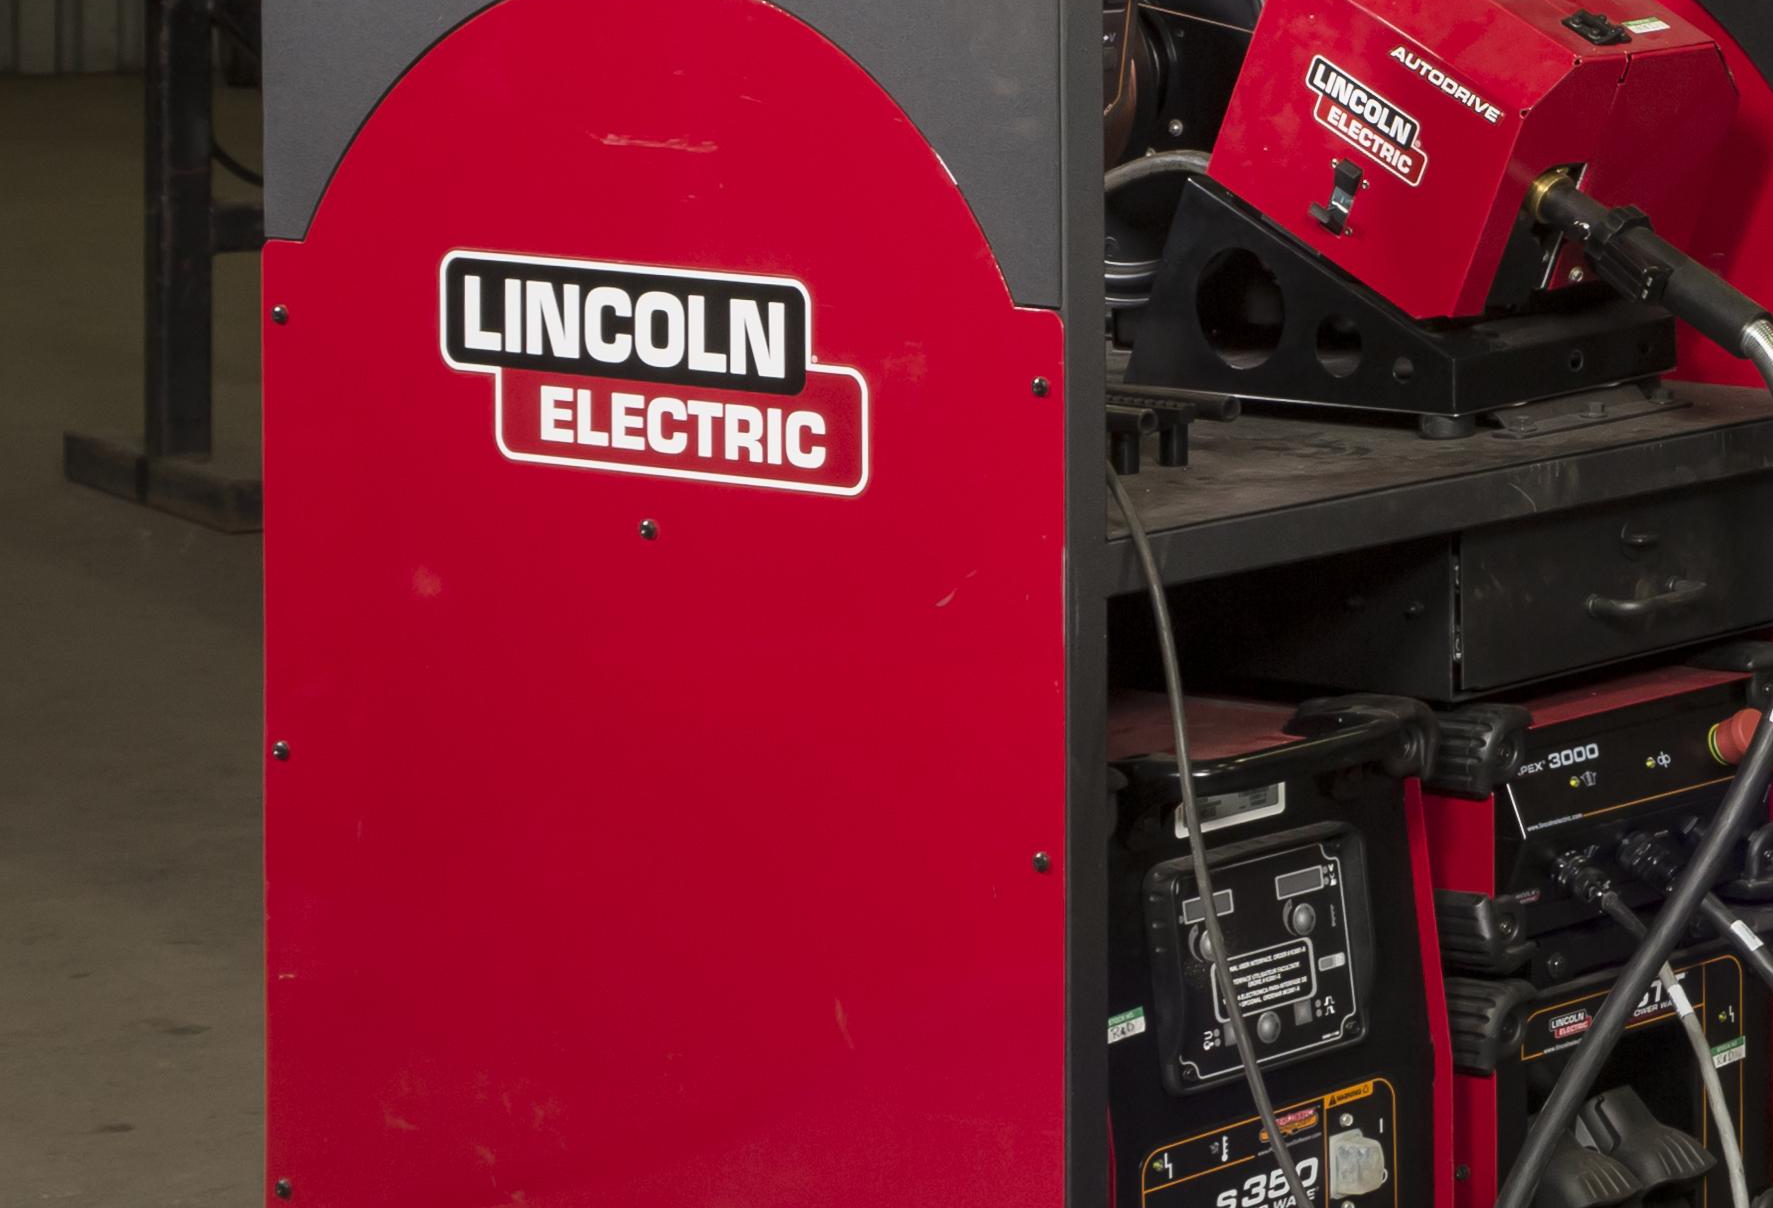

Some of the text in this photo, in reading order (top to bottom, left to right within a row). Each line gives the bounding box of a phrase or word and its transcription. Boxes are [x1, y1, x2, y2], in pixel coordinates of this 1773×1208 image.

[1313, 63, 1412, 146] LINCOLN
[1390, 46, 1501, 124] AUTODRIVE
[1327, 105, 1413, 175] ELECTRIC
[464, 275, 786, 379] LINCOLN
[540, 385, 826, 470] ELECTRIC
[1518, 743, 1599, 776] PEX 3000
[1551, 1011, 1585, 1029] LINCOLN
[1633, 1003, 1659, 1017] OWER
